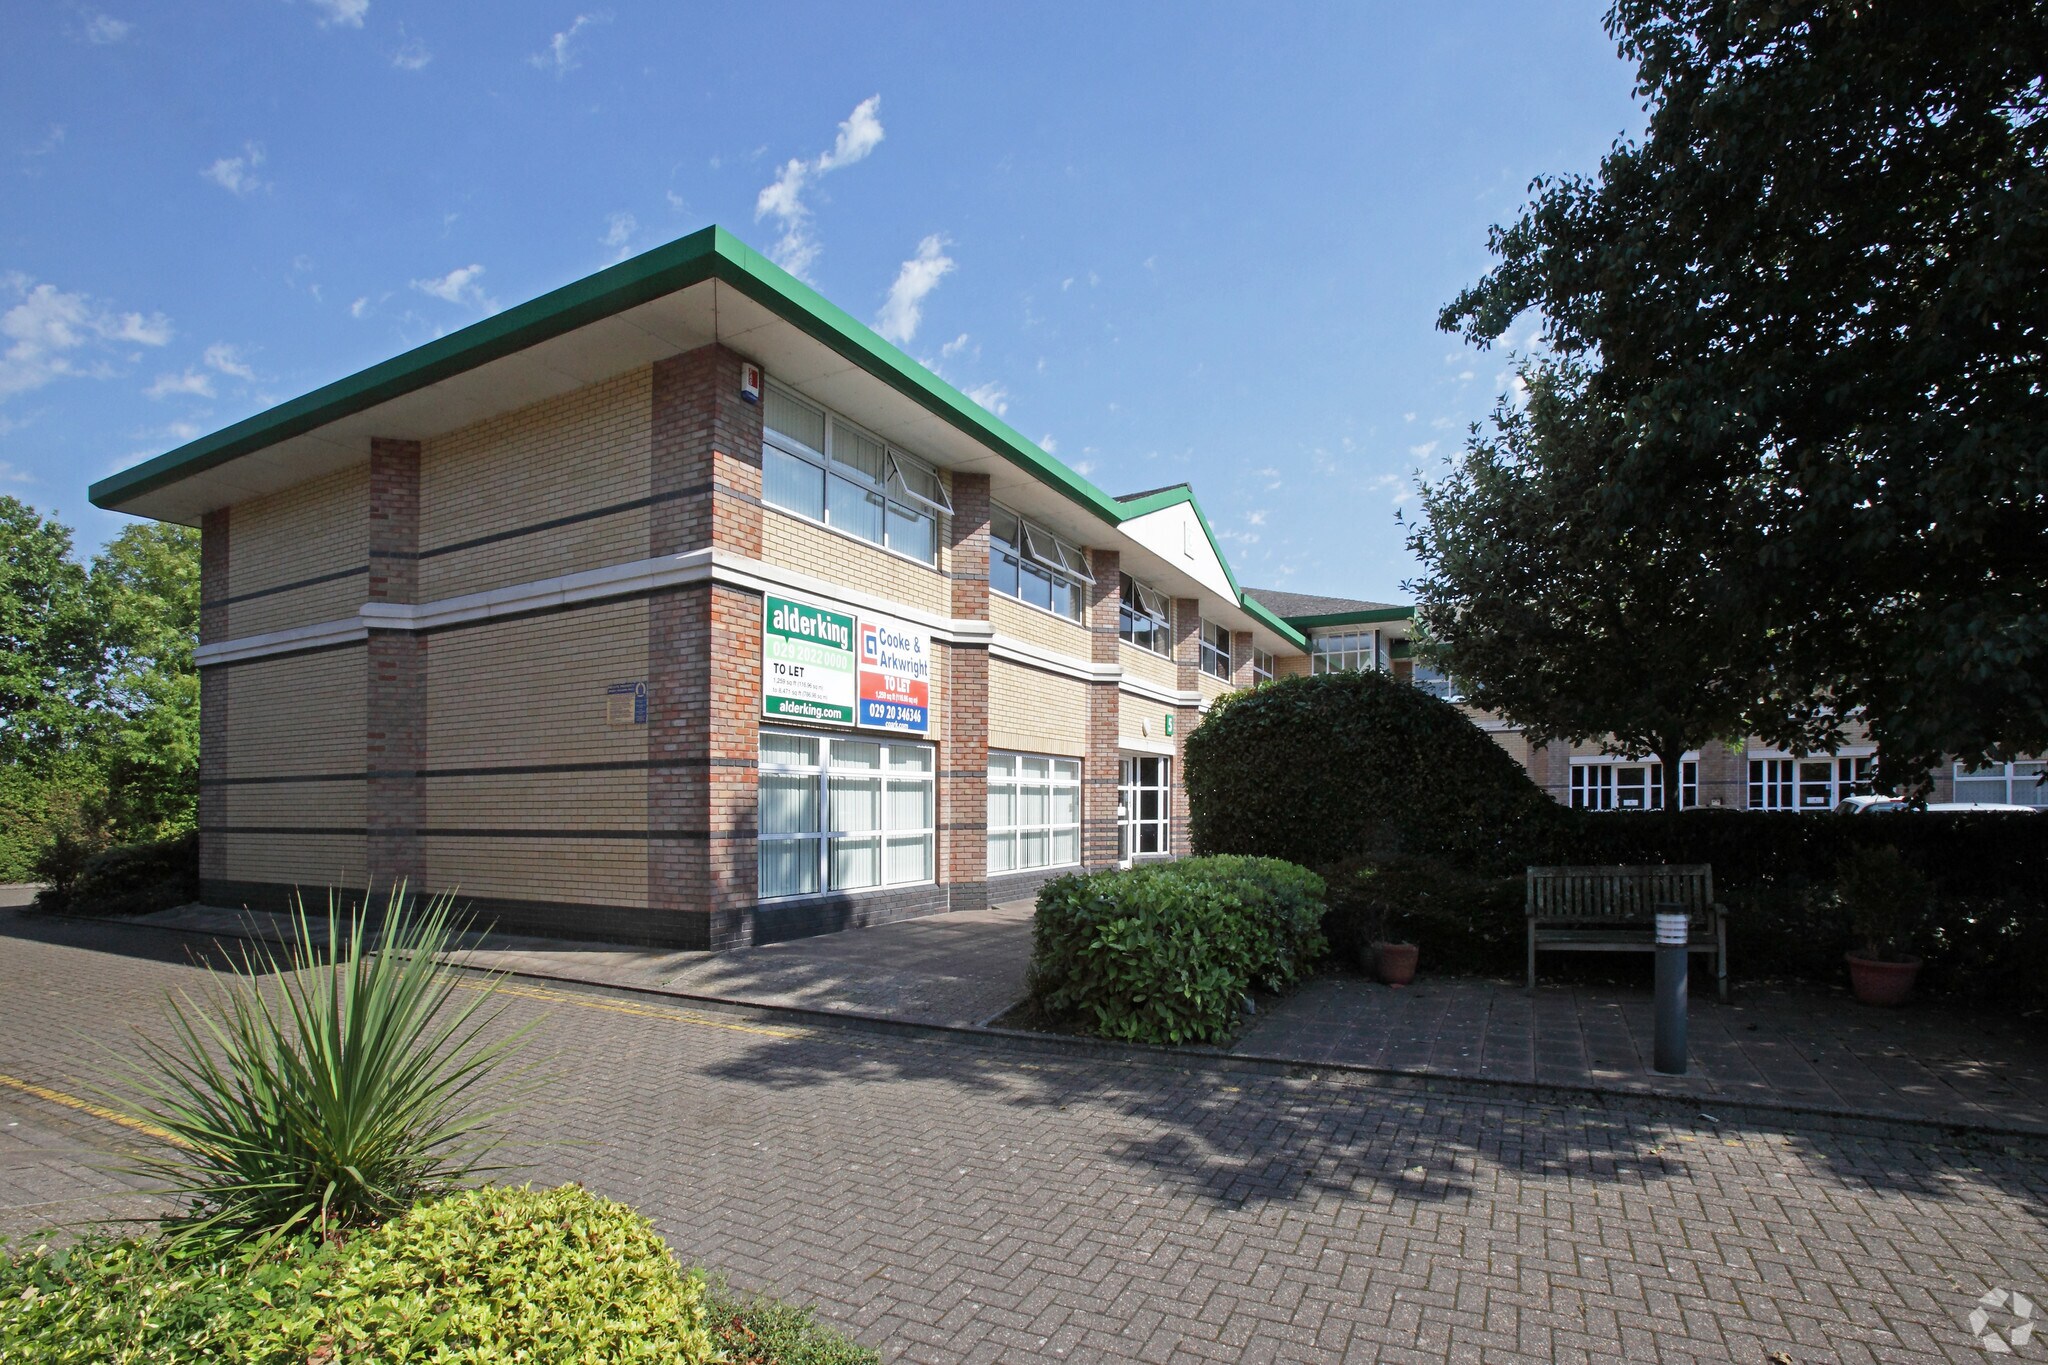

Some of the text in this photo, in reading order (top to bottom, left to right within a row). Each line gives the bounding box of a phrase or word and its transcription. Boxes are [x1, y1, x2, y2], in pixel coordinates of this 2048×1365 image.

[773, 604, 848, 650] alderking
[879, 628, 920, 653] Cooke &
[773, 642, 795, 659] 029
[773, 663, 804, 678] TO LET
[880, 650, 928, 678] Arkwright
[884, 675, 911, 693] TO LET
[779, 700, 842, 719] alderking.com
[869, 703, 921, 723] 029 20 346346
[1167, 718, 1173, 732] 5
